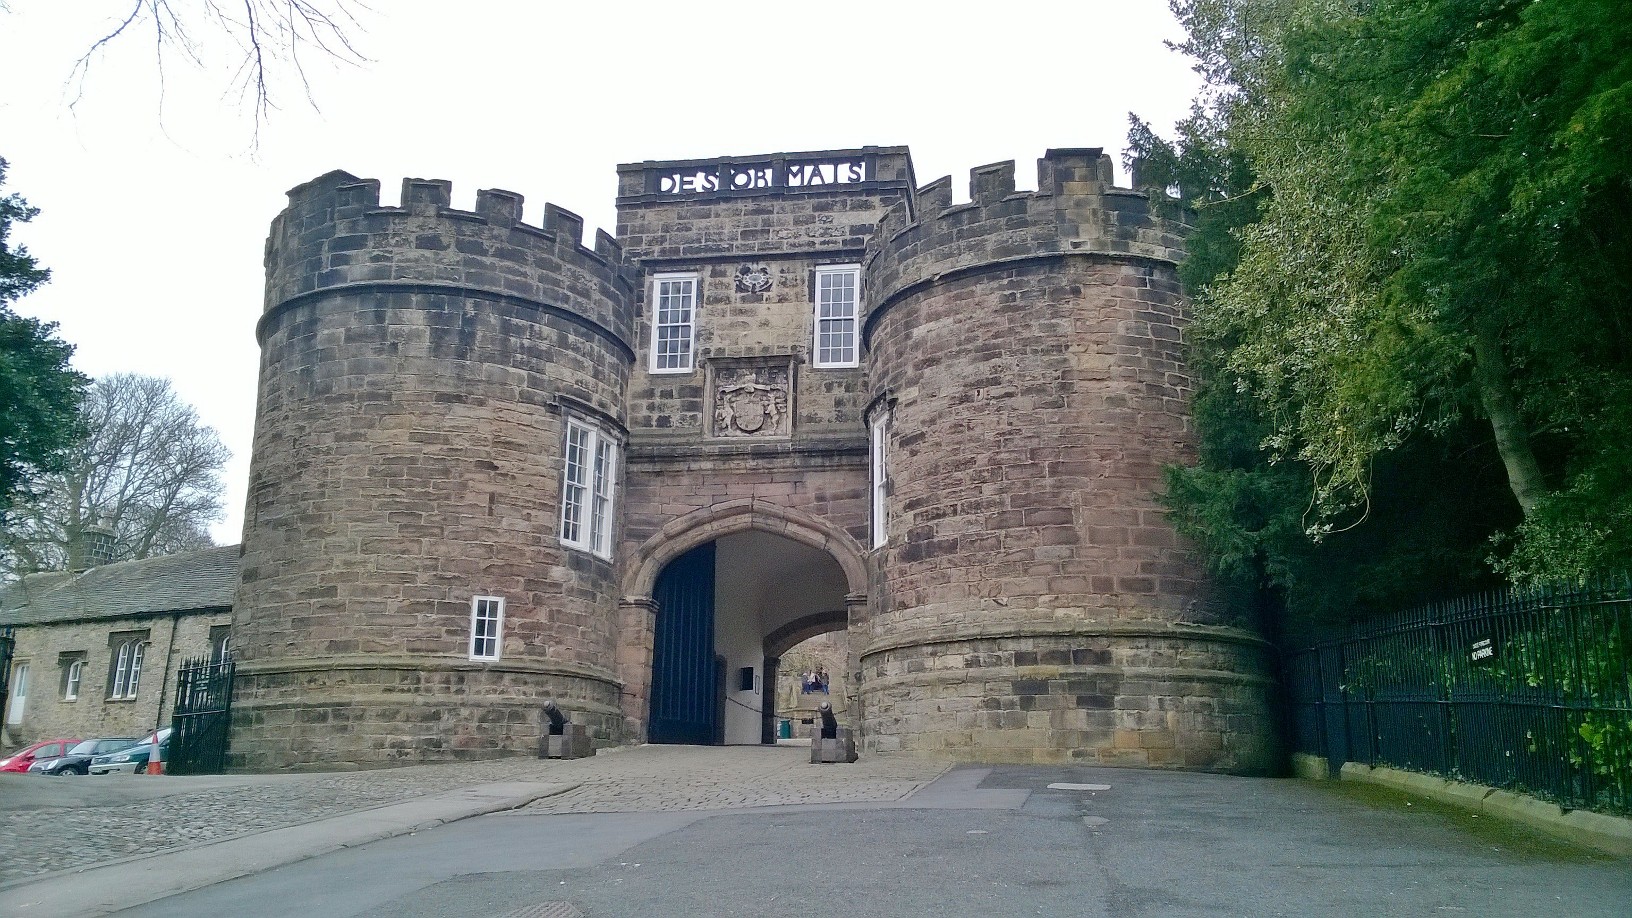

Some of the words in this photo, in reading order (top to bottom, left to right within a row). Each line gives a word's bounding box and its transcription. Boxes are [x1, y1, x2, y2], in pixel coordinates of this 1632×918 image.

[658, 172, 719, 194] DES
[731, 168, 772, 191] OR
[785, 161, 865, 187] MAIS
